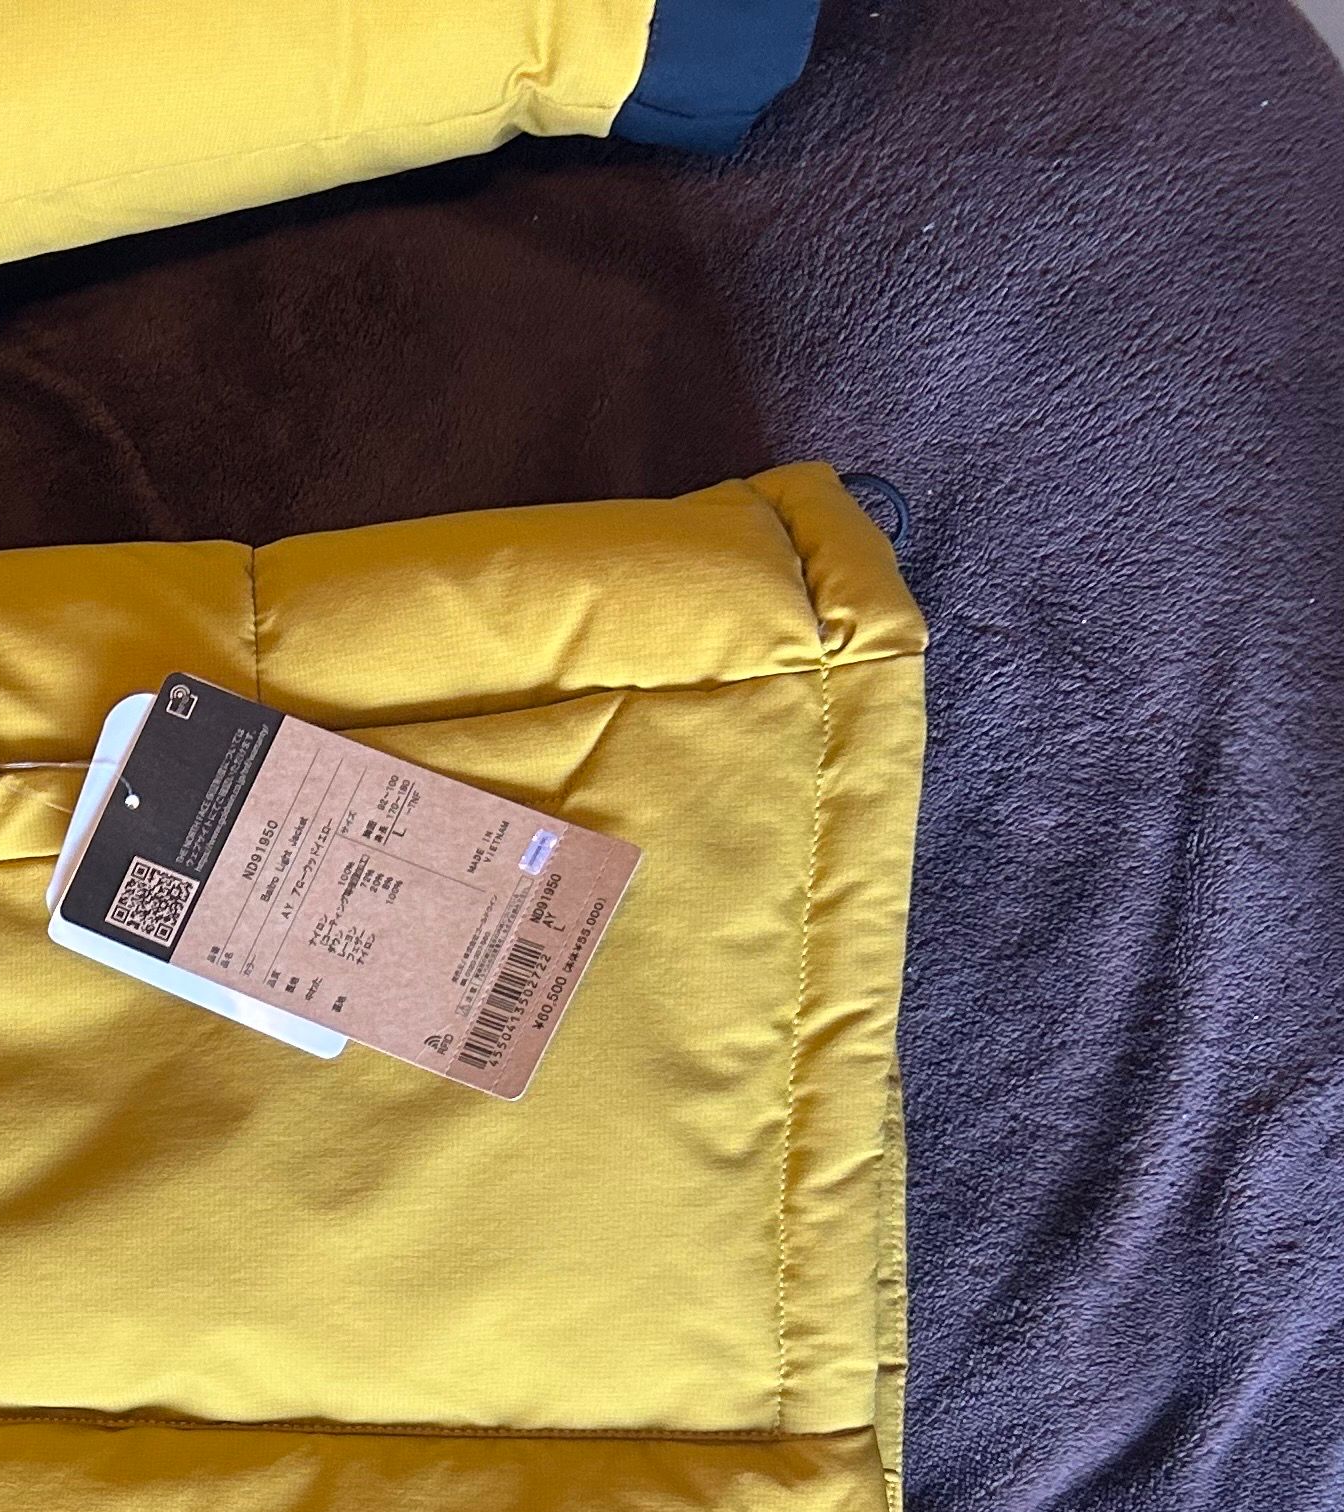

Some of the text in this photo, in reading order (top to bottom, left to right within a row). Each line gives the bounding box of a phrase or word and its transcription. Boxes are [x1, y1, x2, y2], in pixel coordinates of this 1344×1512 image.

[182, 819, 201, 848] NORTH
[195, 799, 211, 821] FACE
[274, 848, 294, 872] Light
[286, 815, 309, 847] Jacket
[339, 810, 357, 834] サイズ
[391, 824, 407, 838] L
[482, 819, 510, 864] VIETNAM
[241, 818, 279, 881] ND91950
[466, 830, 493, 874] MADE IN
[307, 912, 330, 947] ナイロン
[337, 860, 355, 886] 100%
[336, 871, 385, 958] レーヨン 20%
[528, 872, 562, 924] ND91950
[541, 911, 557, 928] AY
[242, 952, 259, 977] カラー
[279, 903, 294, 919] AY
[327, 928, 345, 954] ダウン
[345, 928, 367, 962] フェザー
[355, 931, 377, 966] ナイロン
[384, 878, 403, 906] 100%
[555, 922, 566, 932] L
[488, 952, 551, 1068] 4550413502722
[437, 1033, 454, 1055] RFID
